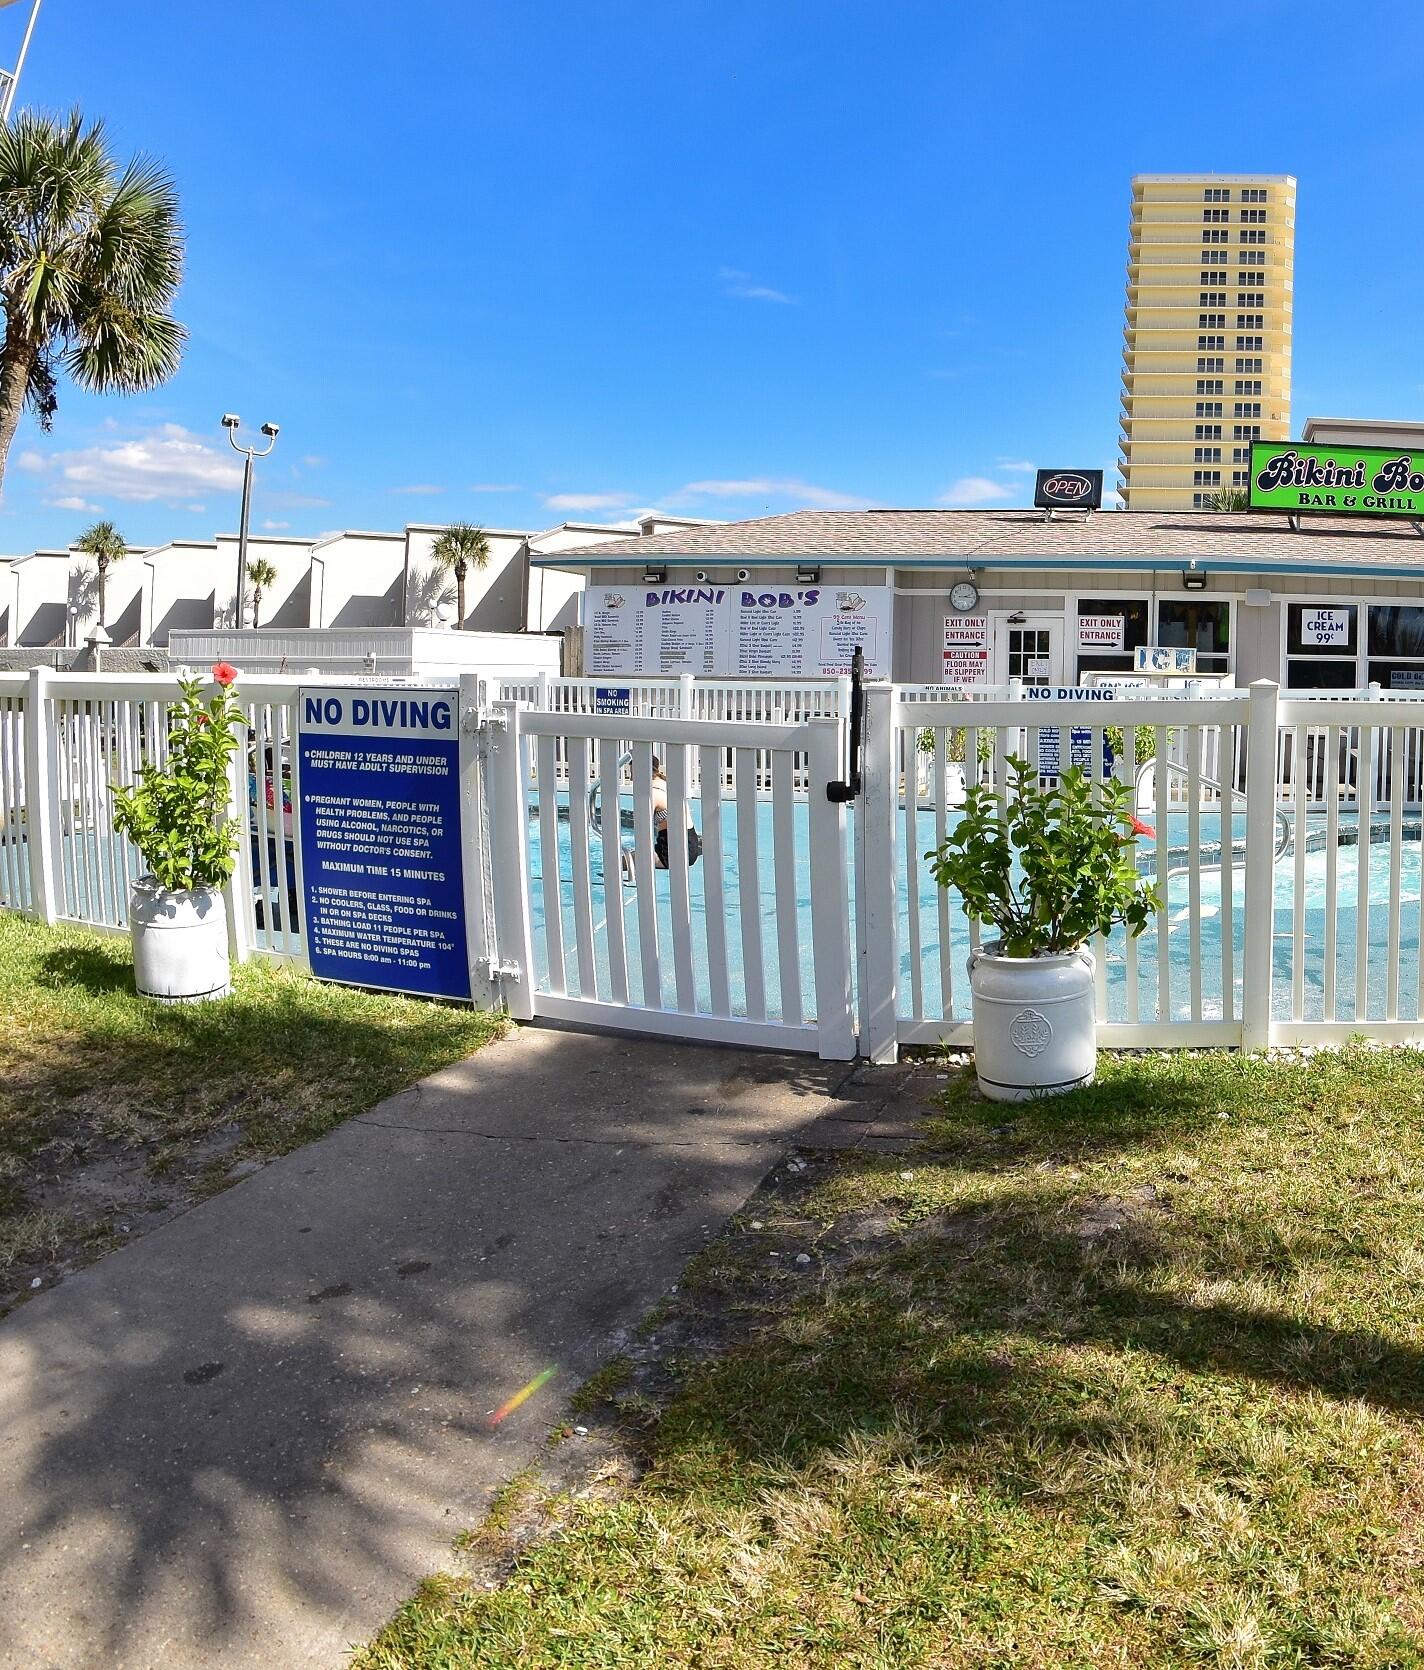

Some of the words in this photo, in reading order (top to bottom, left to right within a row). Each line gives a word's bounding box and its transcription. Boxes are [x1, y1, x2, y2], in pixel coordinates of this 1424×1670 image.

[1257, 451, 1366, 492] Bikini
[1046, 480, 1087, 495] OPEN
[1299, 493, 1336, 506] BAR
[1343, 496, 1357, 507] &
[1363, 496, 1417, 510] GRILL
[646, 588, 725, 607] BIKINI
[741, 589, 821, 609] BOB'S
[945, 619, 965, 627] EXIT
[967, 619, 985, 627] ONLY
[1081, 619, 1098, 627] EXIT
[1100, 619, 1121, 627] ONLY
[1318, 611, 1334, 621] ICE
[1307, 621, 1344, 631] CREAM
[1080, 632, 1121, 640] ENTRANCE
[607, 689, 618, 697] NO
[1029, 688, 1051, 699] NO
[1057, 689, 1114, 700] DIVING
[597, 698, 629, 706] SMOKING
[305, 698, 343, 725] NO
[352, 699, 451, 730] DIVING
[311, 750, 351, 760] CHILDREN
[354, 752, 363, 761] 12
[366, 753, 393, 762] YEARS
[396, 755, 413, 764] AND
[416, 755, 447, 766] UNDER
[311, 760, 334, 769] MUST
[336, 761, 357, 770] HAVE
[359, 762, 387, 772] ADULT
[389, 764, 448, 776] SUPERVISION
[311, 795, 351, 806] PREGNANT
[353, 798, 384, 809] WOMEN,
[386, 800, 417, 811] PEOPLE
[419, 803, 439, 812] WITH
[316, 807, 345, 817] HEALTH
[346, 809, 390, 821] PROBLEMS,
[392, 813, 409, 822] AND
[411, 814, 442, 824] PEOPLE
[316, 818, 339, 827] USING
[341, 820, 379, 832] ALCOHOL,
[381, 824, 429, 836] NARCOTICS,
[431, 827, 443, 836] OR
[316, 829, 342, 838] DRUGS
[344, 831, 375, 842] SHOULD
[377, 835, 393, 844] NOT
[395, 837, 412, 846] USE
[414, 838, 429, 847] SPA
[317, 841, 351, 851] WITHOUT
[353, 844, 391, 855] DOCTOR'S
[393, 847, 433, 859] CONSENT.
[322, 861, 364, 873] MAXIMUM
[366, 865, 388, 876] TIME
[390, 868, 401, 877] 15
[404, 869, 445, 881] MINUTES
[318, 886, 348, 897] SHOWER
[349, 890, 377, 900] BEFORE
[379, 893, 414, 904] ENTERING
[417, 897, 431, 906] SPA
[312, 896, 318, 904] 2.
[320, 897, 329, 905] NO
[331, 898, 366, 910] COOLERS,
[367, 902, 393, 913] GLASS,
[394, 905, 414, 915] FOOD
[416, 907, 427, 916] OR
[428, 909, 457, 920] DRINKS
[329, 908, 339, 916] OR
[341, 909, 351, 917] ON
[353, 911, 366, 920] SPA
[368, 912, 392, 923] DECKS
[313, 916, 320, 924] 3.
[321, 917, 351, 928] BATHING
[353, 921, 371, 931] LOAD
[373, 924, 381, 932] 11
[384, 925, 412, 936] PEOPLE
[414, 928, 428, 937] PER
[430, 930, 445, 940] SPA
[314, 926, 320, 934] 4.
[322, 928, 355, 938] MAXIMUM
[357, 931, 381, 942] WATER
[383, 935, 436, 949] TEMPERATURE
[315, 936, 321, 944] 5.
[323, 937, 344, 947] THESE
[345, 940, 359, 949] ARE
[361, 942, 371, 951] NO
[373, 943, 398, 955] DIVING
[400, 947, 419, 957] SPAS
[323, 947, 336, 956] SPA
[338, 949, 362, 960] HOURS
[381, 956, 391, 964] am
[398, 958, 417, 968] 11:00
[419, 961, 431, 970] pm
